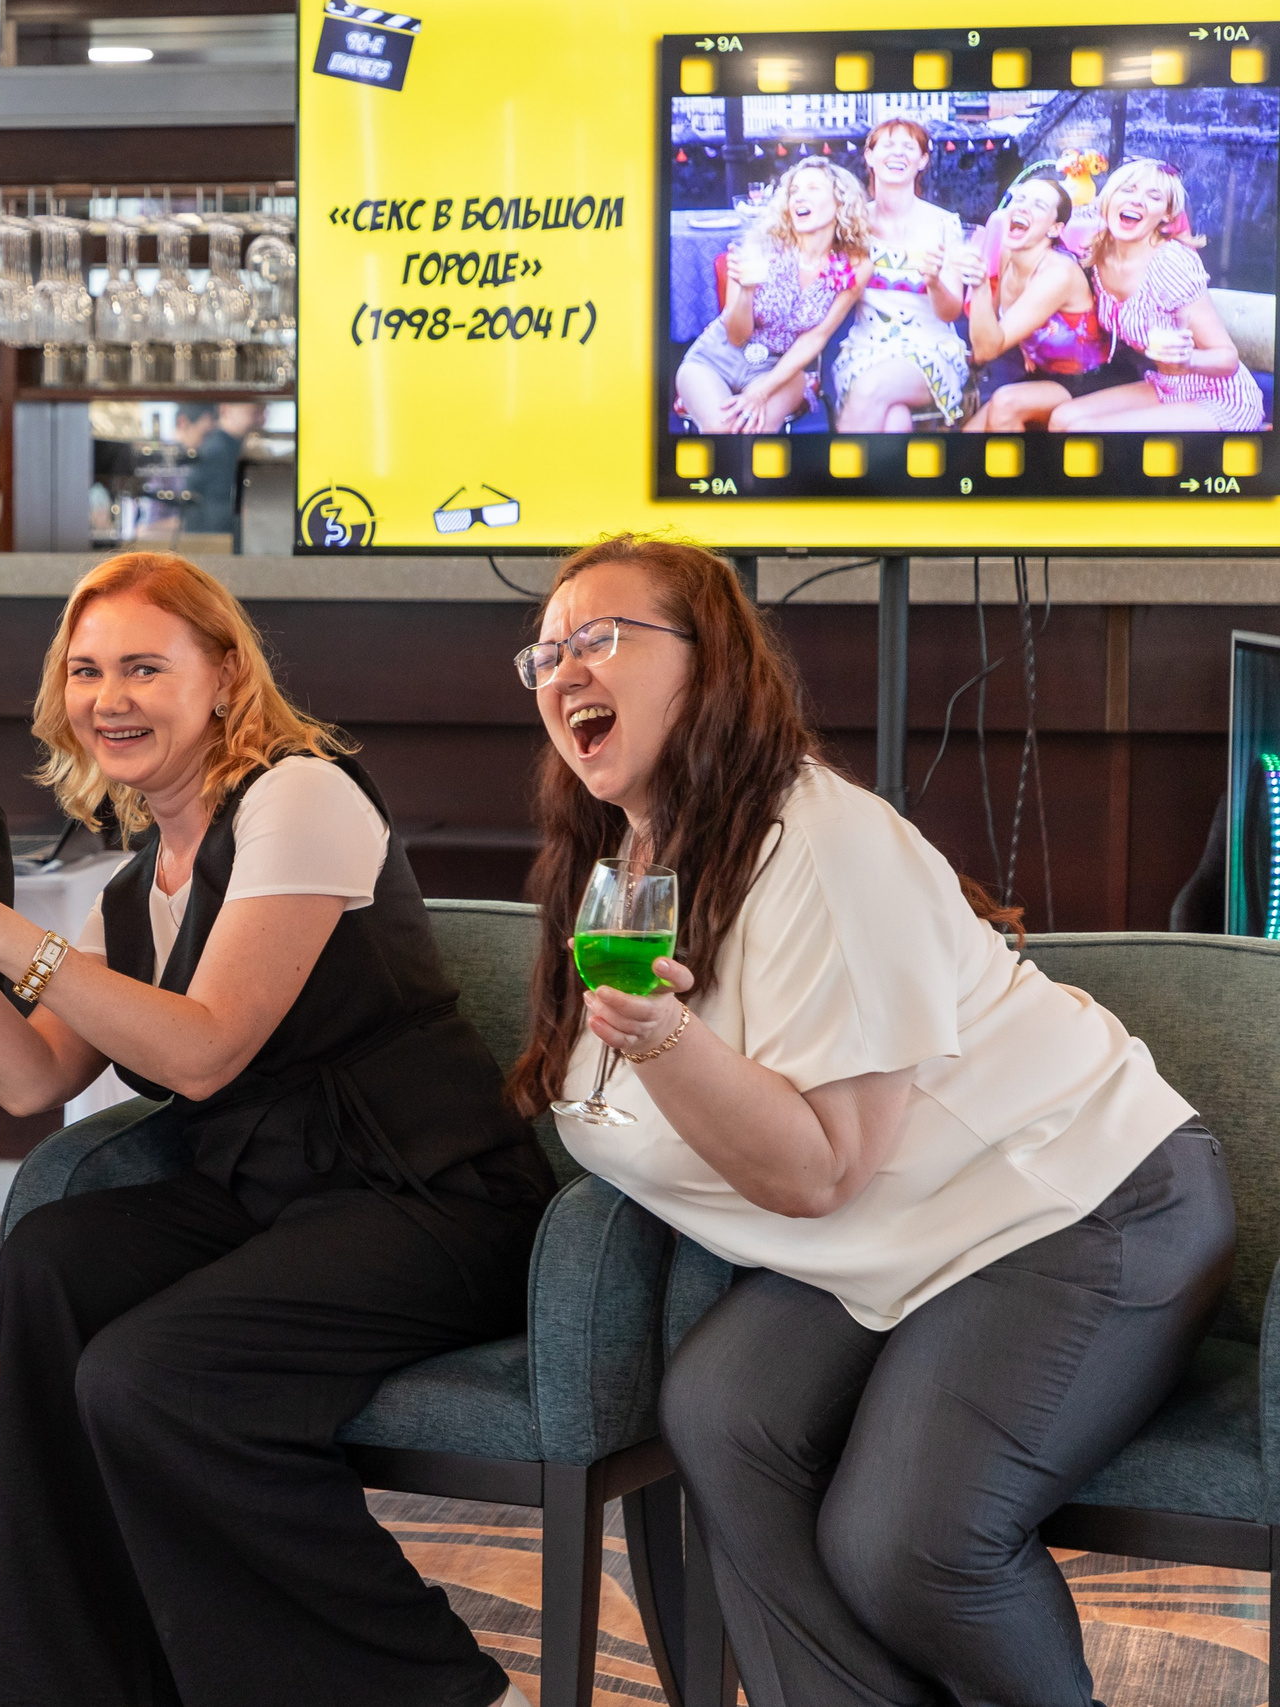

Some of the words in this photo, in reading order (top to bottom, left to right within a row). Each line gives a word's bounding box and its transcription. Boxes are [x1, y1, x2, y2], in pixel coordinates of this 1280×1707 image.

[968, 31, 980, 47] 9
[1213, 26, 1250, 42] 10A
[717, 36, 742, 52] 9A
[432, 199, 453, 232] В
[461, 195, 624, 231] БОЛЬШОМ
[402, 251, 542, 288] ГОРОДЕ»
[351, 301, 553, 346] (1998-2004
[712, 478, 738, 495] 9A
[959, 478, 973, 494] 9
[1204, 477, 1240, 494] 10A
